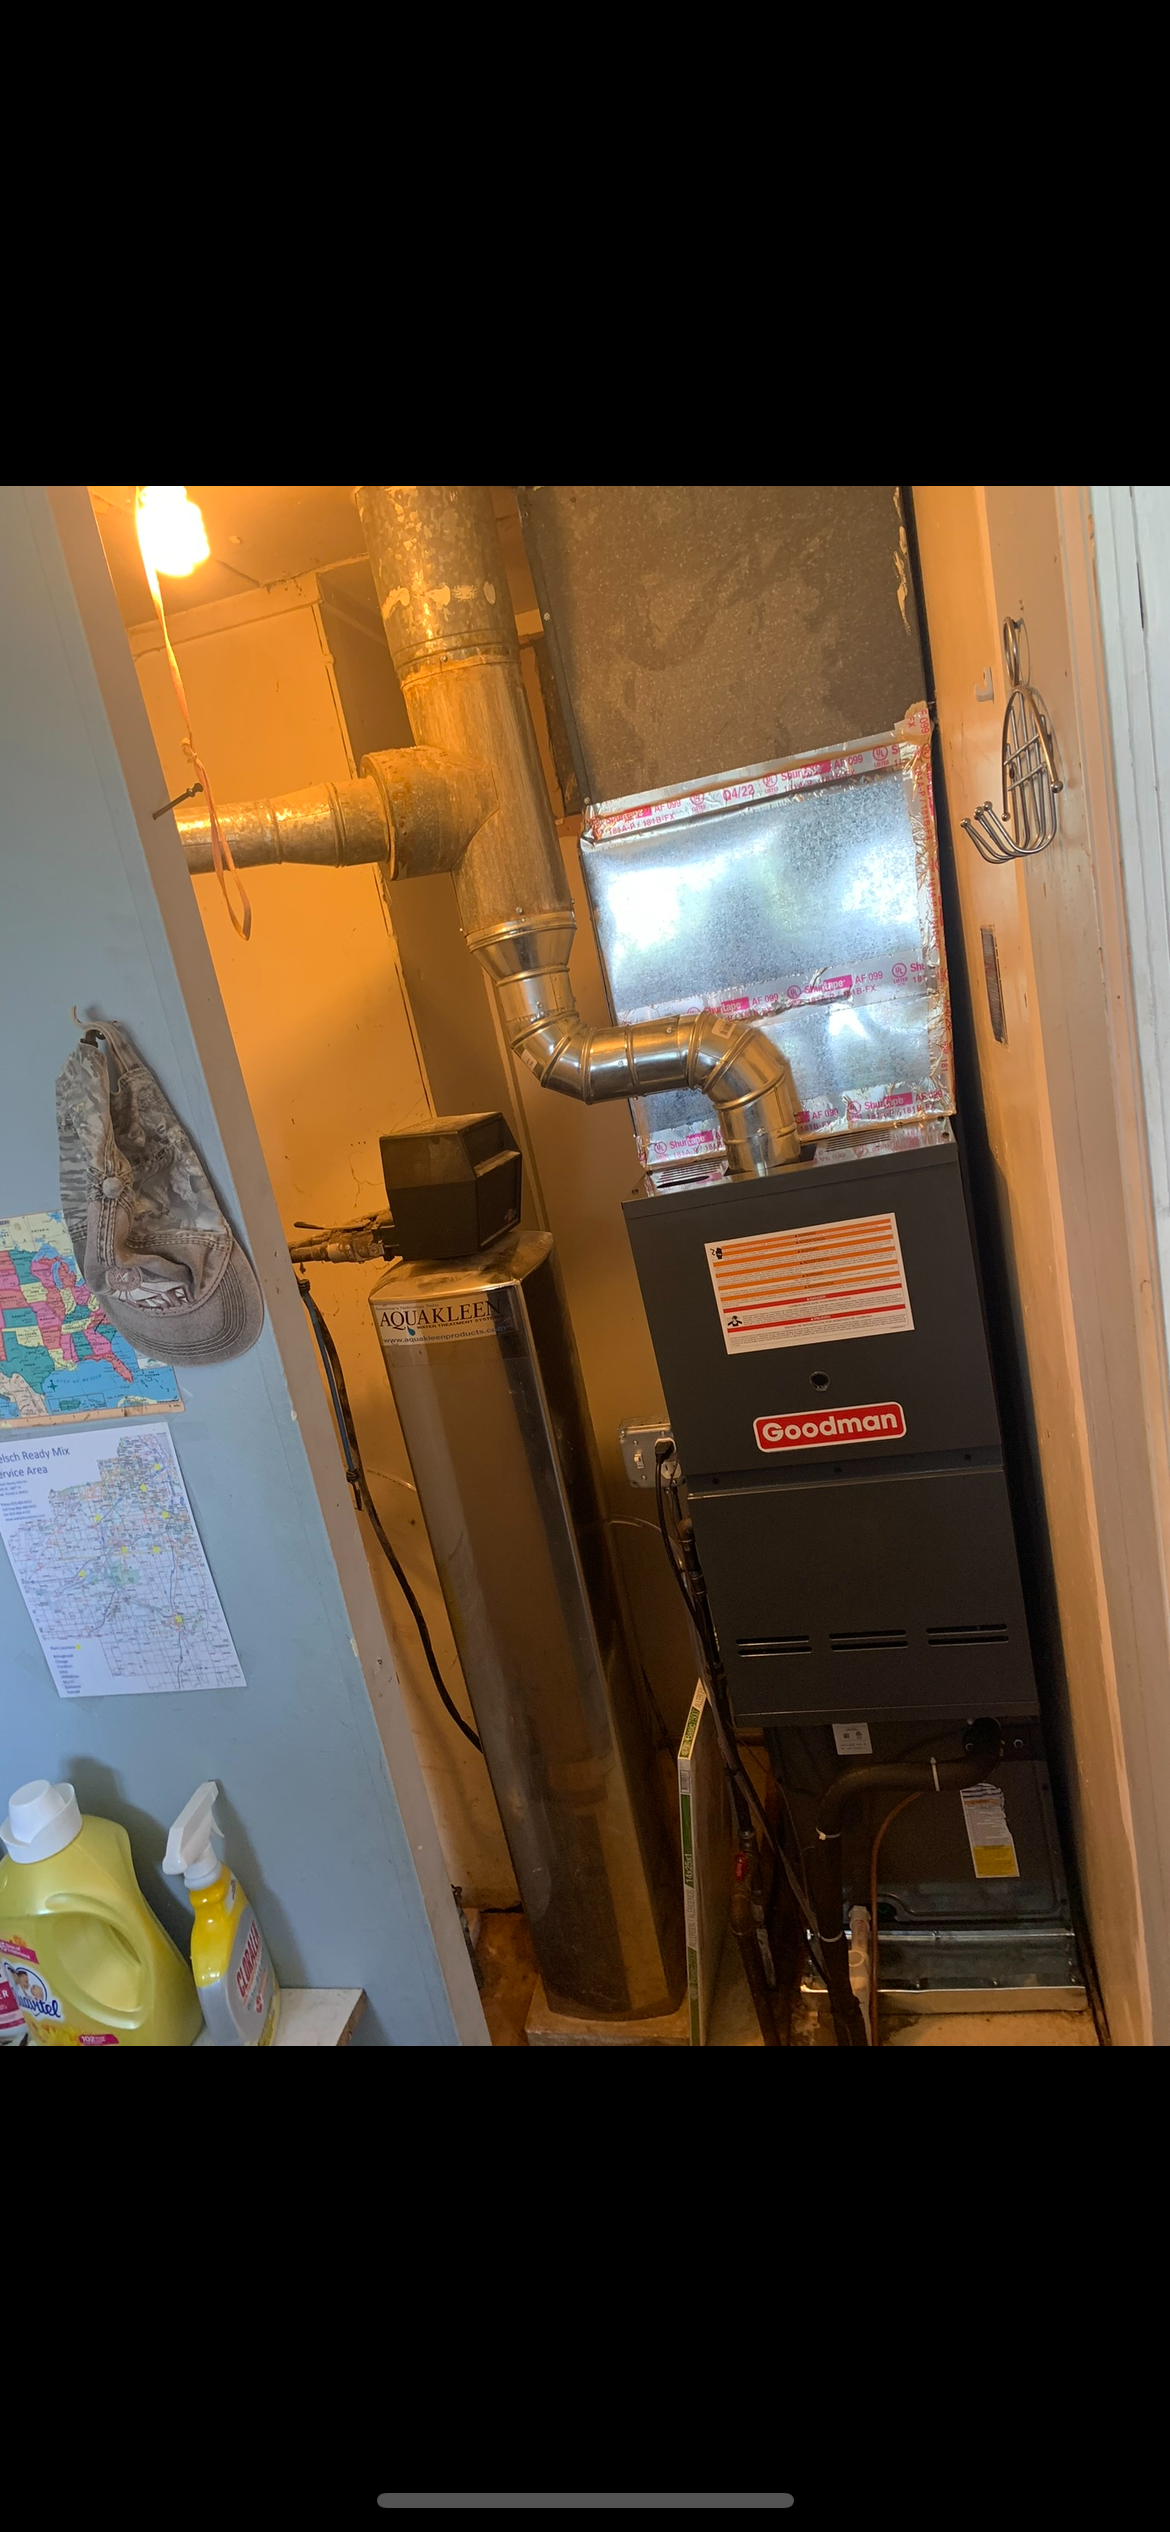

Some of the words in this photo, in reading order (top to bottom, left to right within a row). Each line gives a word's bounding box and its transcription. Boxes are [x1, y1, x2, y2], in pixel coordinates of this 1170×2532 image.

[848, 754, 863, 765] 099
[722, 784, 755, 802] Q4/22
[855, 975, 866, 984] AF
[868, 970, 883, 981] 099
[752, 996, 763, 1005] AF
[764, 992, 779, 1003] 099
[812, 1111, 823, 1121] AF
[380, 1299, 501, 1330] AQUAKLEEN
[383, 1325, 507, 1344] www.aquakleenproducts.com
[762, 1413, 898, 1442] Goodman
[21, 1448, 50, 1460] Ready
[51, 1446, 70, 1457] Mix
[26, 1466, 48, 1476] Area
[685, 1853, 693, 1883] 14x25x1
